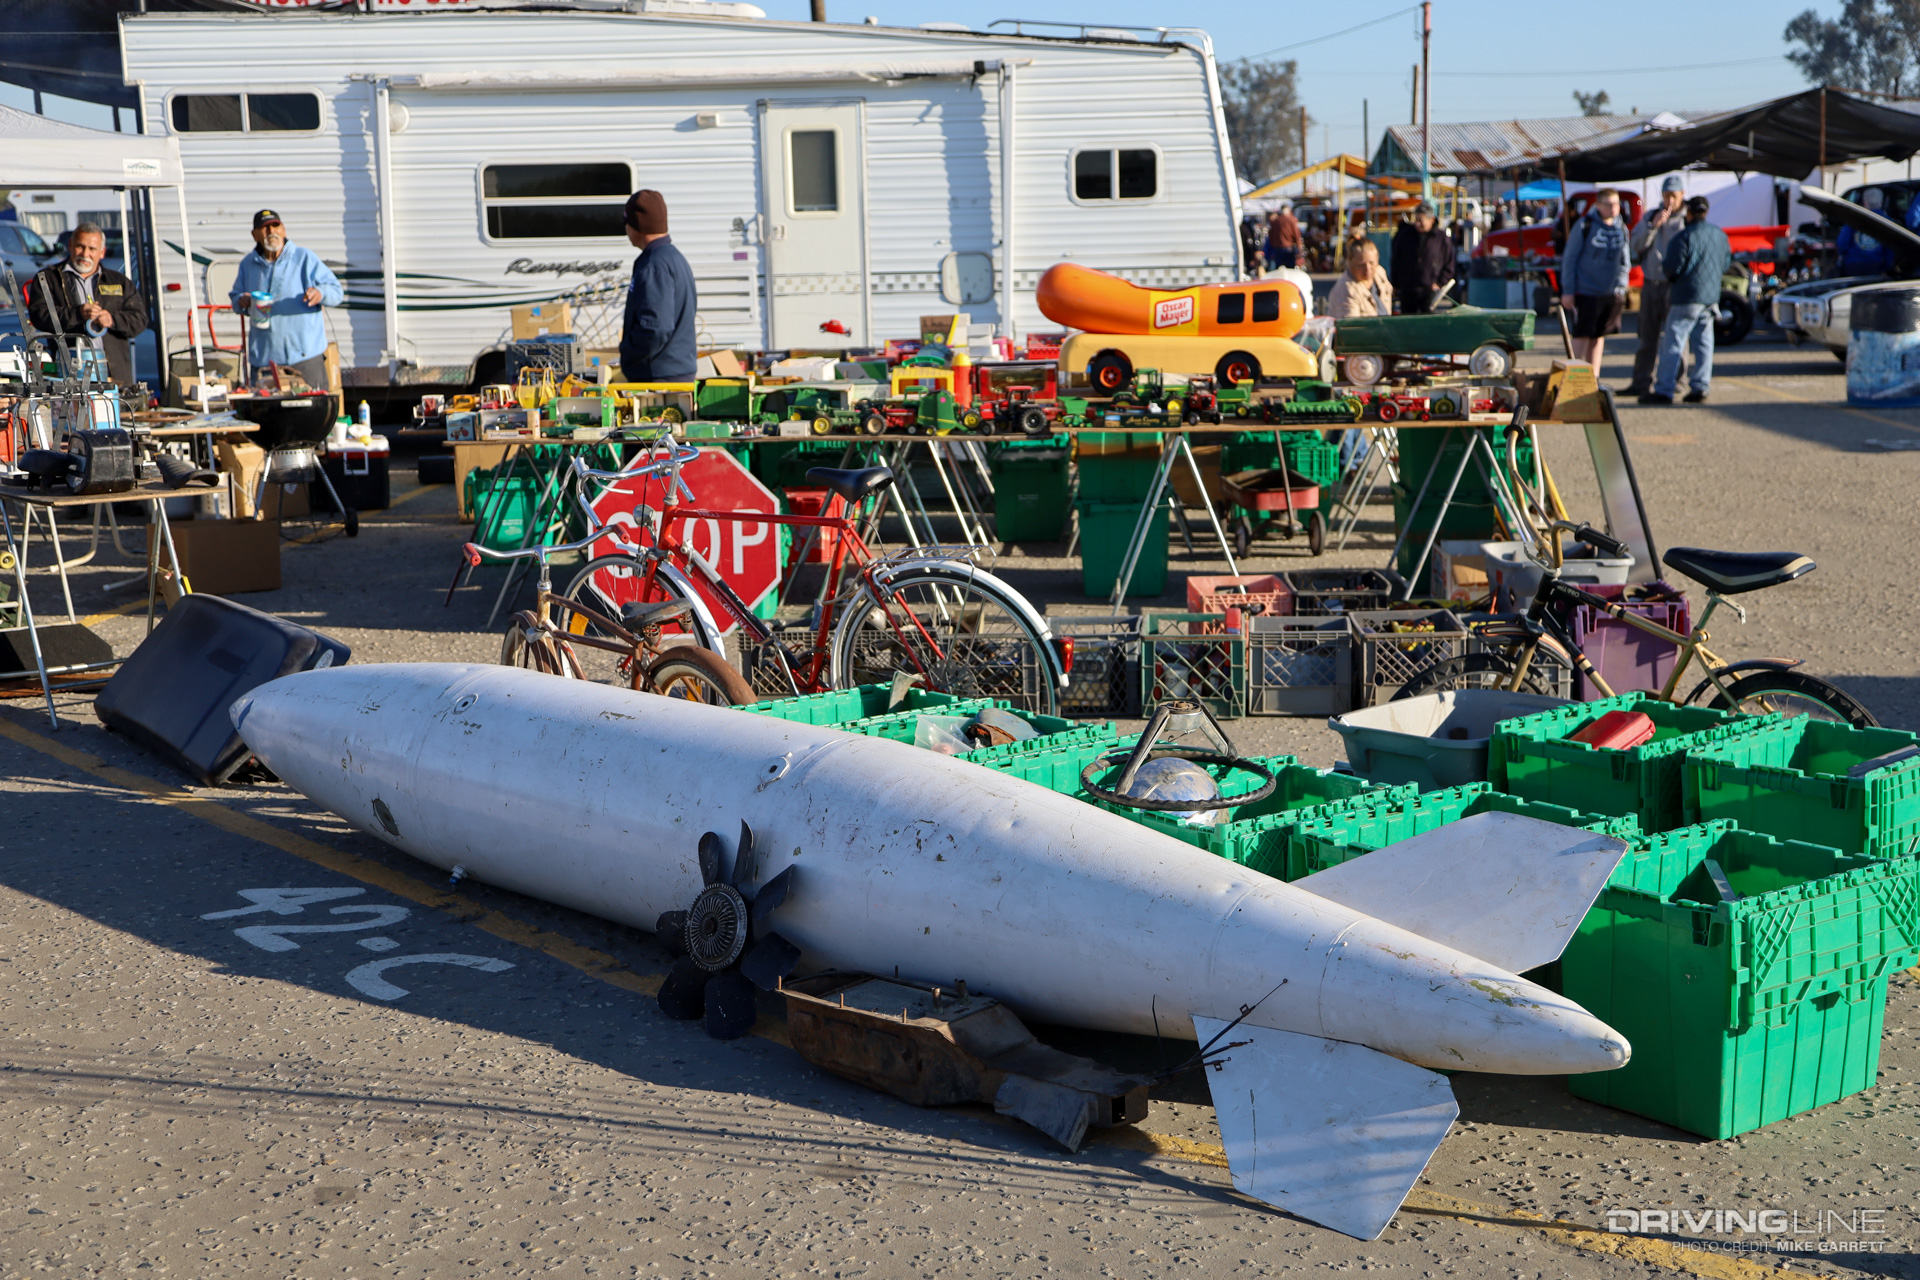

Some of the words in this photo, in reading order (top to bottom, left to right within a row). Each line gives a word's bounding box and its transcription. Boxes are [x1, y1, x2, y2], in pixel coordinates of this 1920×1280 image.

[504, 257, 623, 278] Rampage
[1160, 310, 1189, 323] Mayer
[1162, 302, 1187, 313] Oscar
[605, 508, 770, 580] SOP
[722, 602, 748, 630] CORTINA
